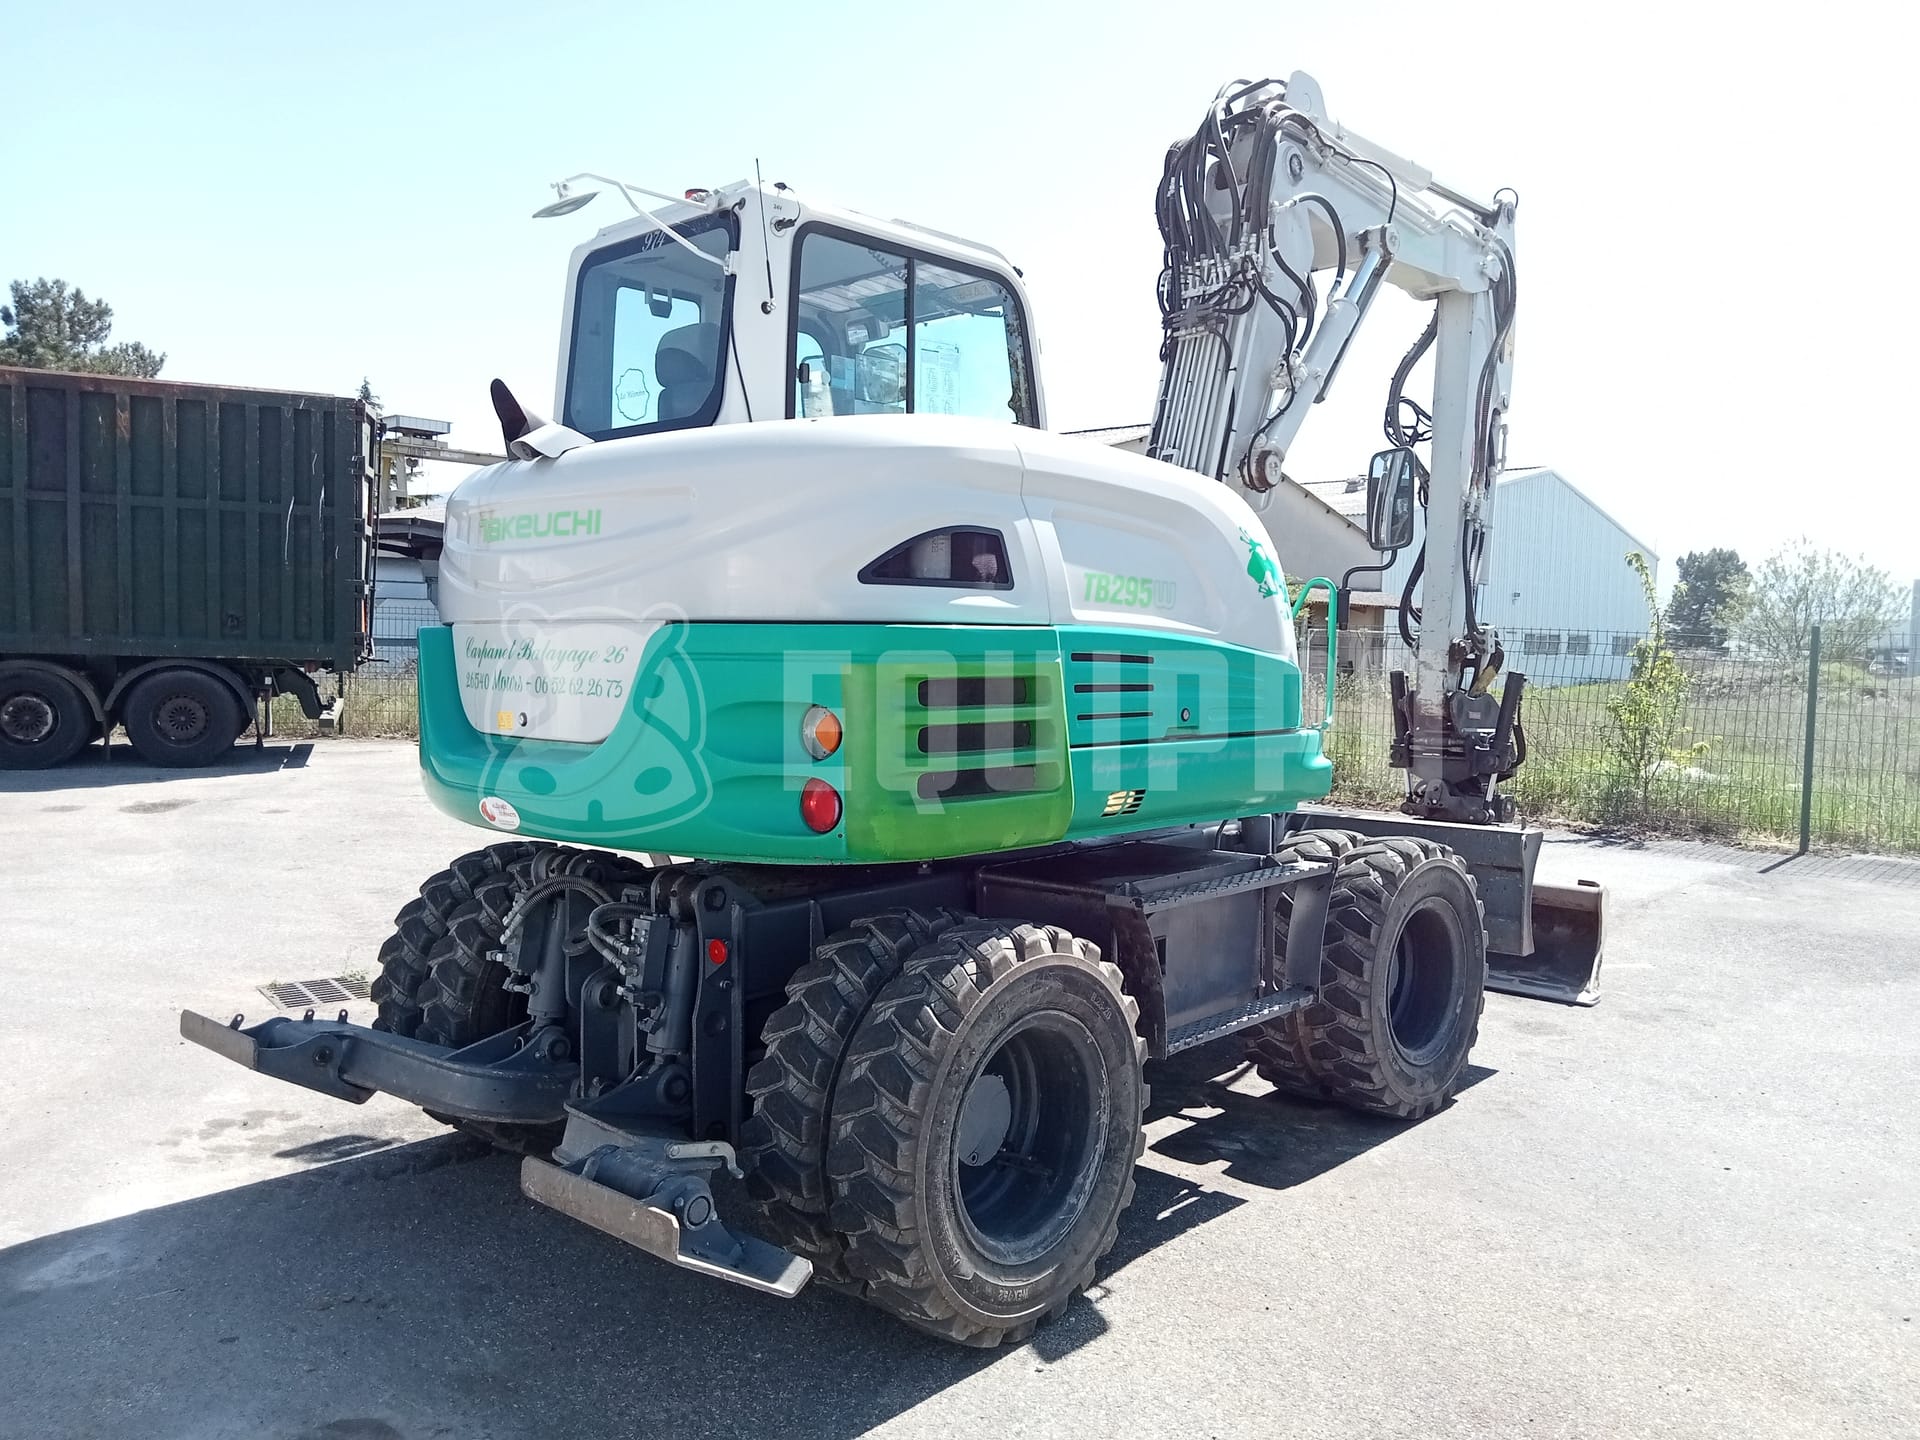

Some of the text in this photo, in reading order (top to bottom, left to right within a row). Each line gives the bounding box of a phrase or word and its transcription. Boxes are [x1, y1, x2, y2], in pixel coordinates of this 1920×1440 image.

[642, 230, 666, 254] 974
[1084, 572, 1177, 610] TB295W
[517, 634, 601, 672] Balayage
[603, 645, 629, 664] 26
[534, 675, 549, 694] 06
[551, 676, 567, 695] 52
[586, 677, 604, 697] 26
